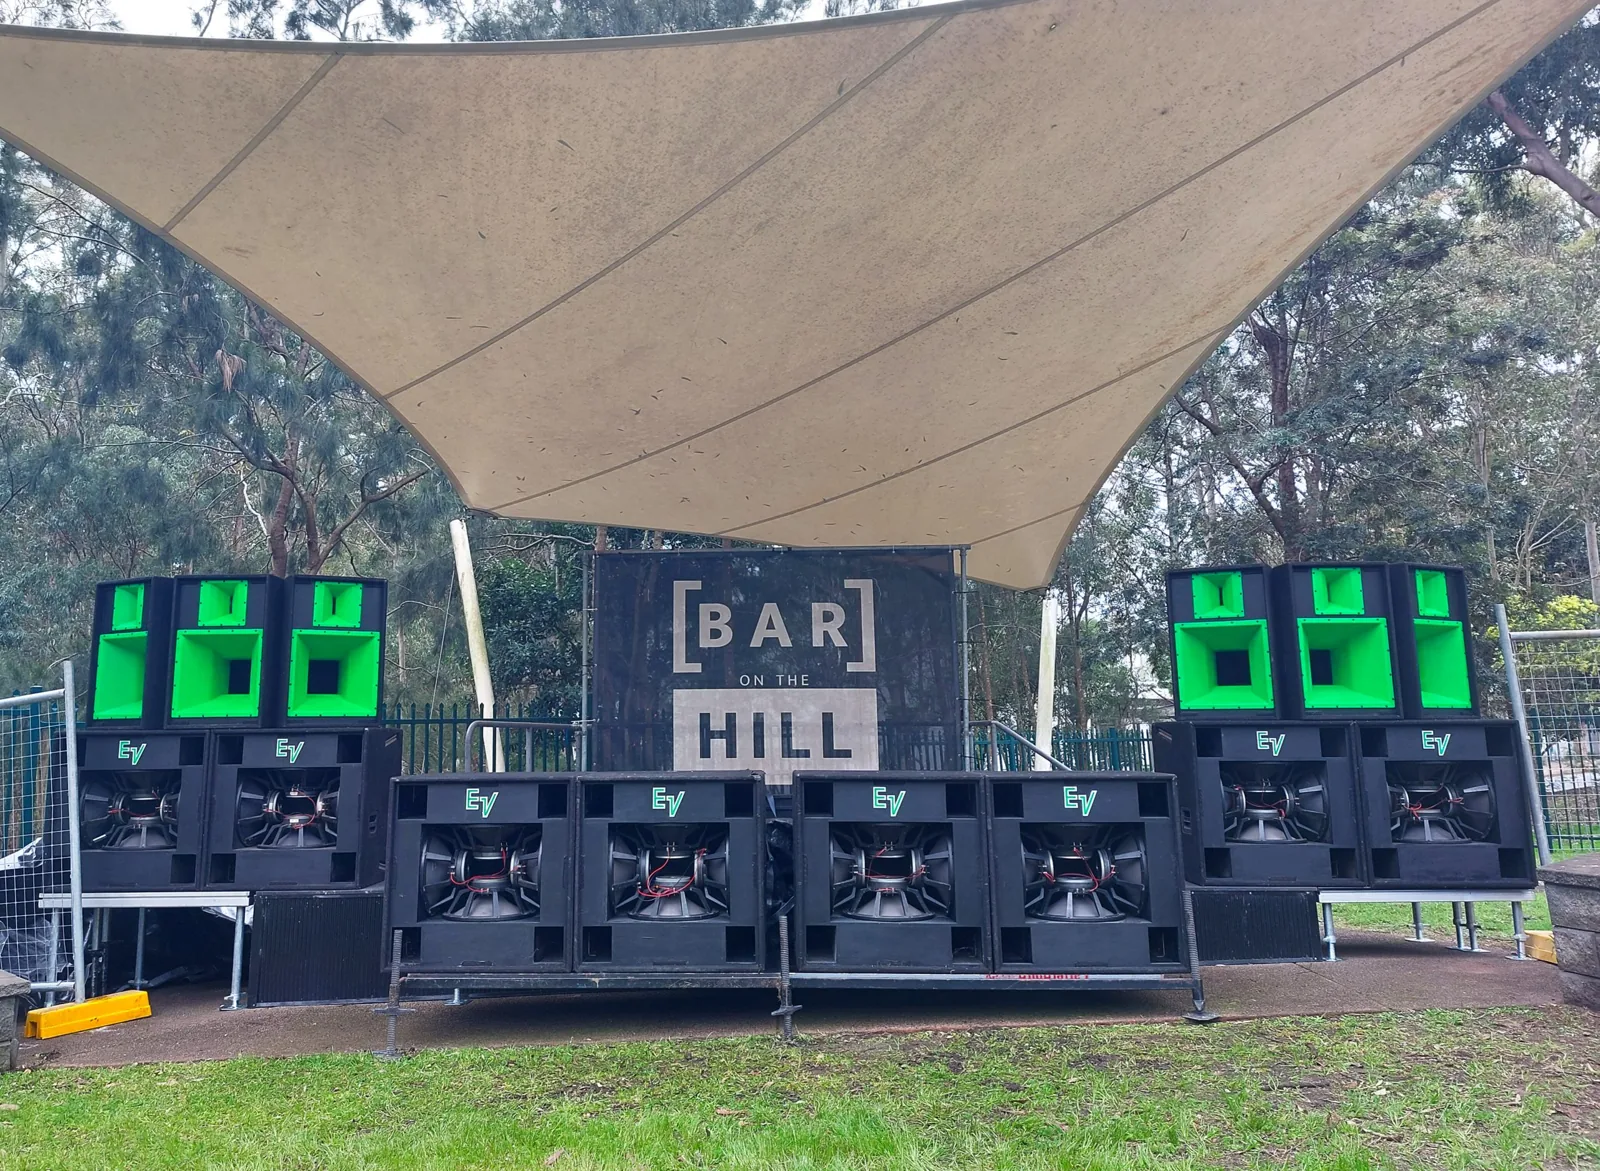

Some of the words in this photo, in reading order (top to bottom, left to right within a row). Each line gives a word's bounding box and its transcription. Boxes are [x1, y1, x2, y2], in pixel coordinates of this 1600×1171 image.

[739, 674, 764, 687] ON
[775, 674, 809, 687] THE
[699, 712, 852, 759] HILL
[1255, 730, 1286, 757] EV
[1421, 729, 1452, 757] EV
[117, 740, 147, 766] EV
[275, 738, 305, 764] EV
[465, 787, 499, 819] EV
[651, 786, 686, 818] EV
[872, 786, 907, 818] EV
[1062, 785, 1098, 817] EV
